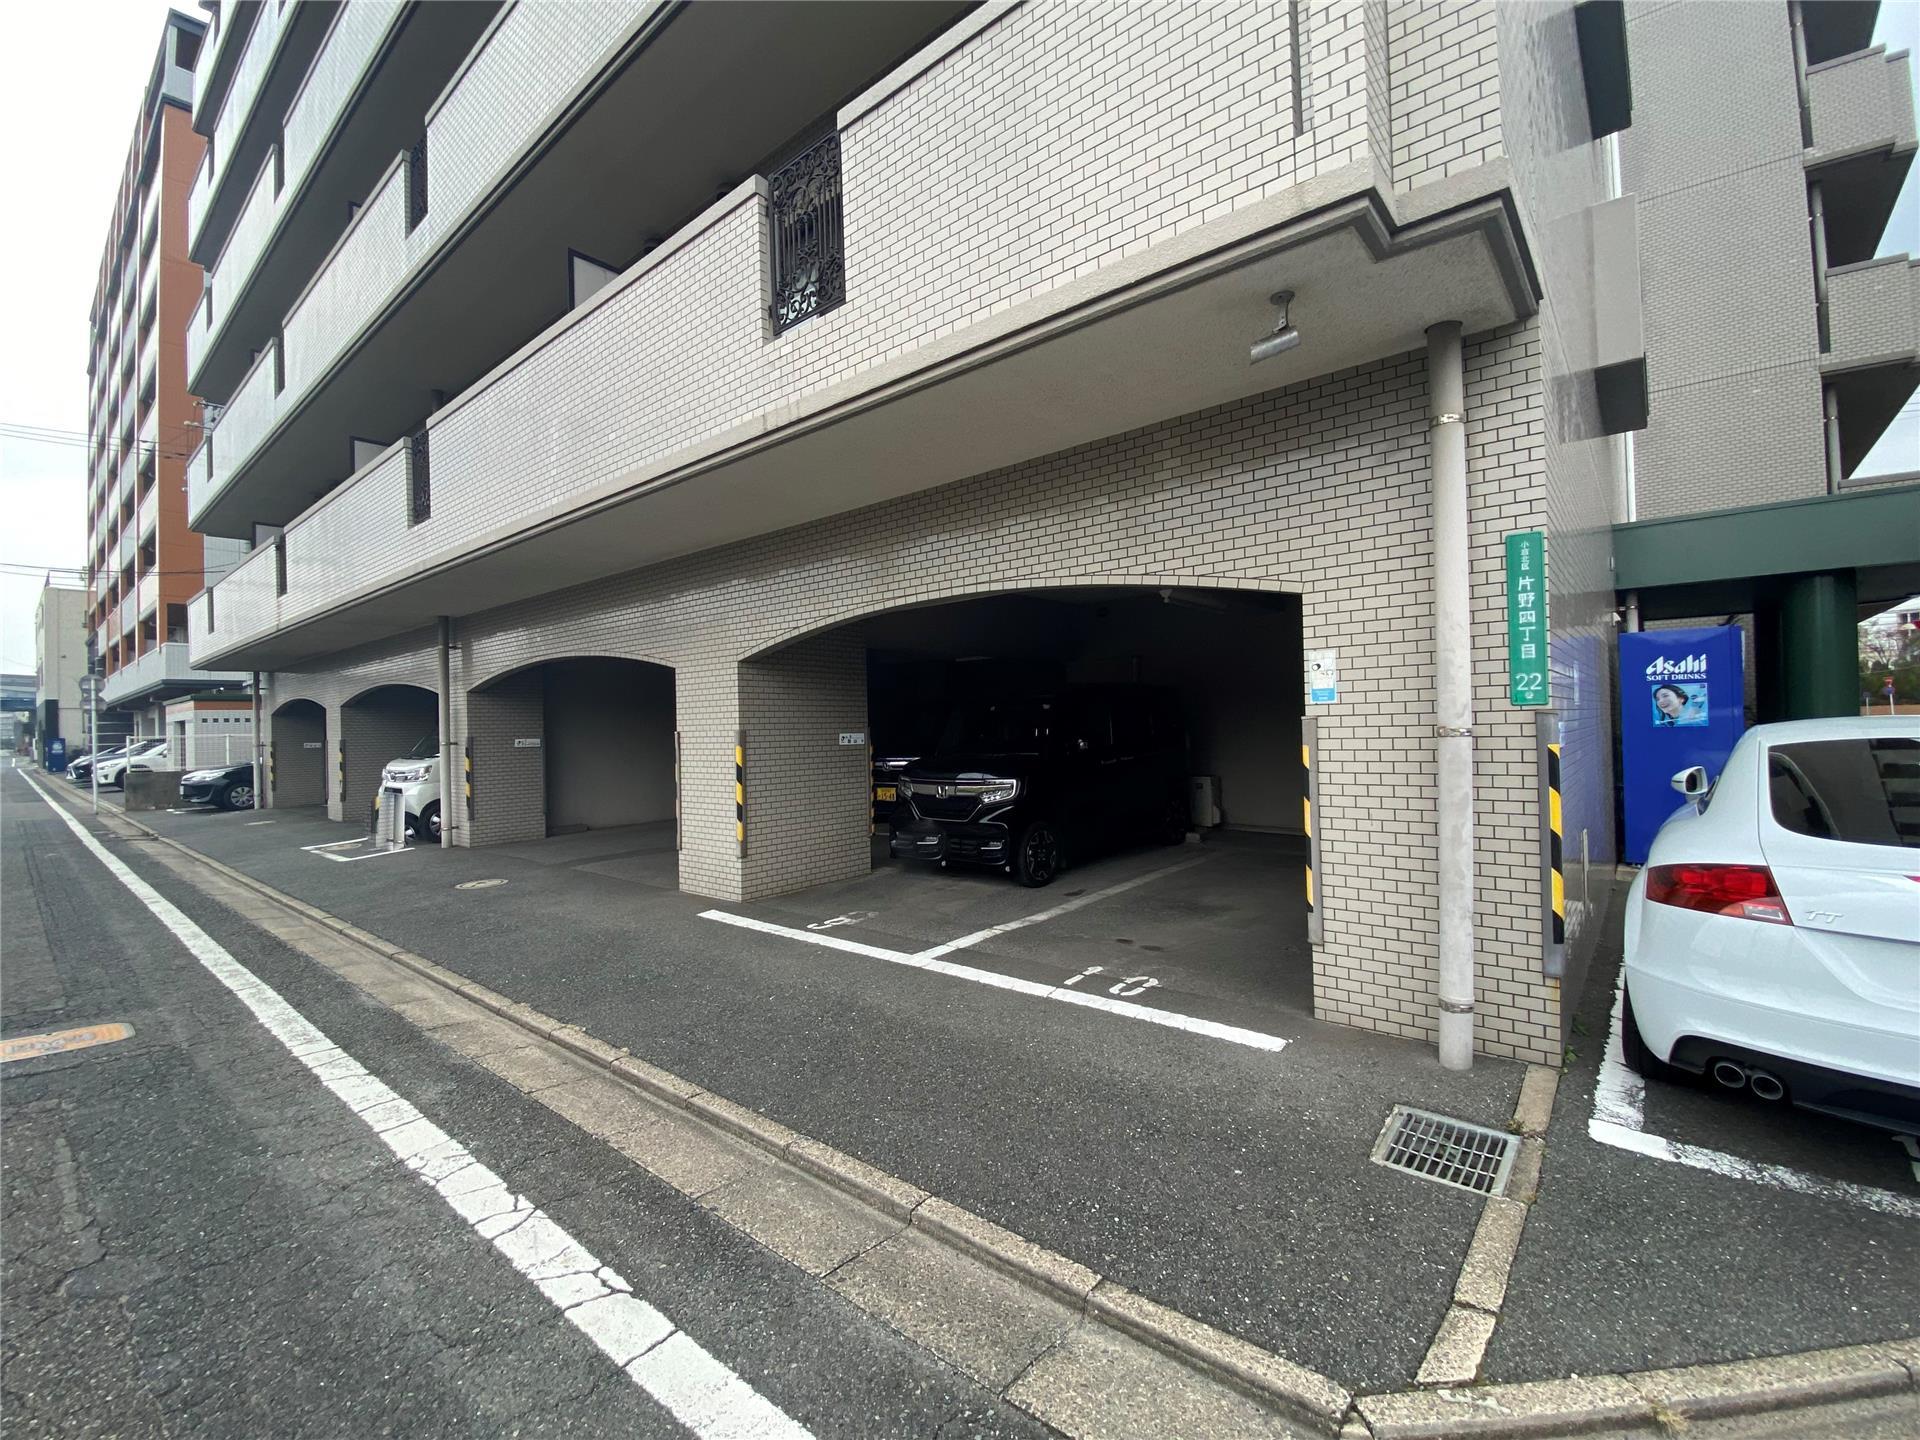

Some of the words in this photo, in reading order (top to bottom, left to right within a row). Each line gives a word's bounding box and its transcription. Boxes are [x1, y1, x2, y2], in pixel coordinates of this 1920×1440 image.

[1518, 576, 1536, 659] 片野四丁目
[1646, 653, 1706, 674] Asahi
[1515, 672, 1542, 691] 22
[1805, 911, 1843, 924] TT
[1064, 966, 1160, 996] 10
